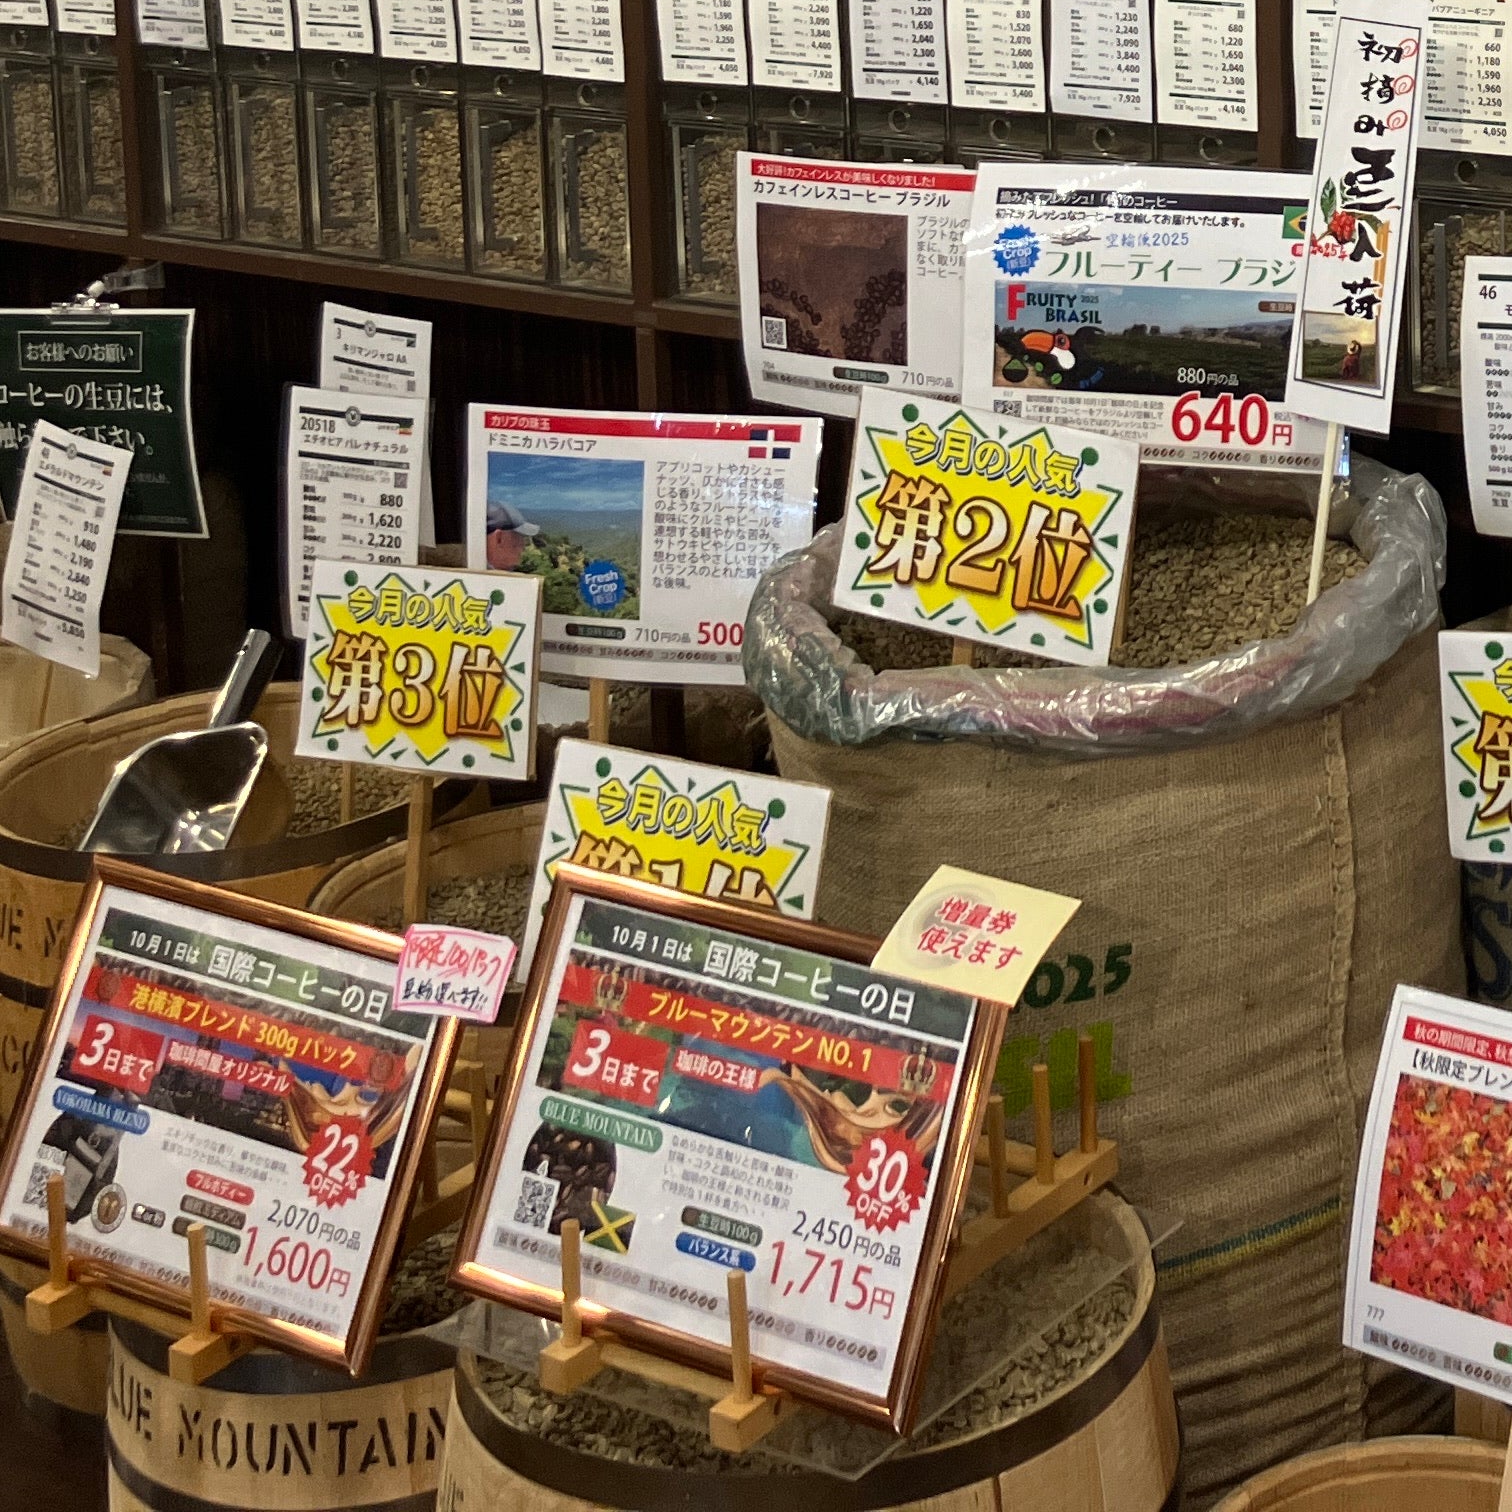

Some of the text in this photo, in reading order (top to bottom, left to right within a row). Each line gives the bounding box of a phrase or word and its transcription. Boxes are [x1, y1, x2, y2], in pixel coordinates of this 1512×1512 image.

[895, 191, 951, 209] ブラジル
[1046, 250, 1202, 282] フルーティー
[1007, 284, 1077, 320] FRUITY
[1046, 308, 1102, 324] BRASIL
[1479, 283, 1497, 301] 46
[300, 417, 336, 434] 20518
[487, 433, 532, 448] ドミニカ
[1170, 392, 1293, 447] 640円
[906, 423, 1081, 496] 今月の人気
[869, 470, 1094, 621] 第2位
[348, 584, 494, 634] 今月の人気
[323, 630, 507, 739] 第3位
[596, 779, 767, 855] 今月の人気
[939, 897, 1017, 932] 増量券
[918, 927, 1023, 969] 使えます
[130, 930, 200, 964] 10月1日は
[207, 944, 389, 1022] 国際コーヒーの日
[611, 924, 915, 1023] 10月1日は 国際コーヒーの日
[648, 991, 812, 1053] ブルーマウンテン
[79, 1025, 153, 1083] 3日まで
[573, 1029, 758, 1094] 3日まで 珈琲の王様
[545, 1100, 655, 1147] BLUE MOUNTAIN
[311, 1173, 341, 1196] OFF
[856, 1196, 892, 1224] OFF
[242, 1227, 351, 1294] 1,600円
[767, 1241, 893, 1318] 1,715円
